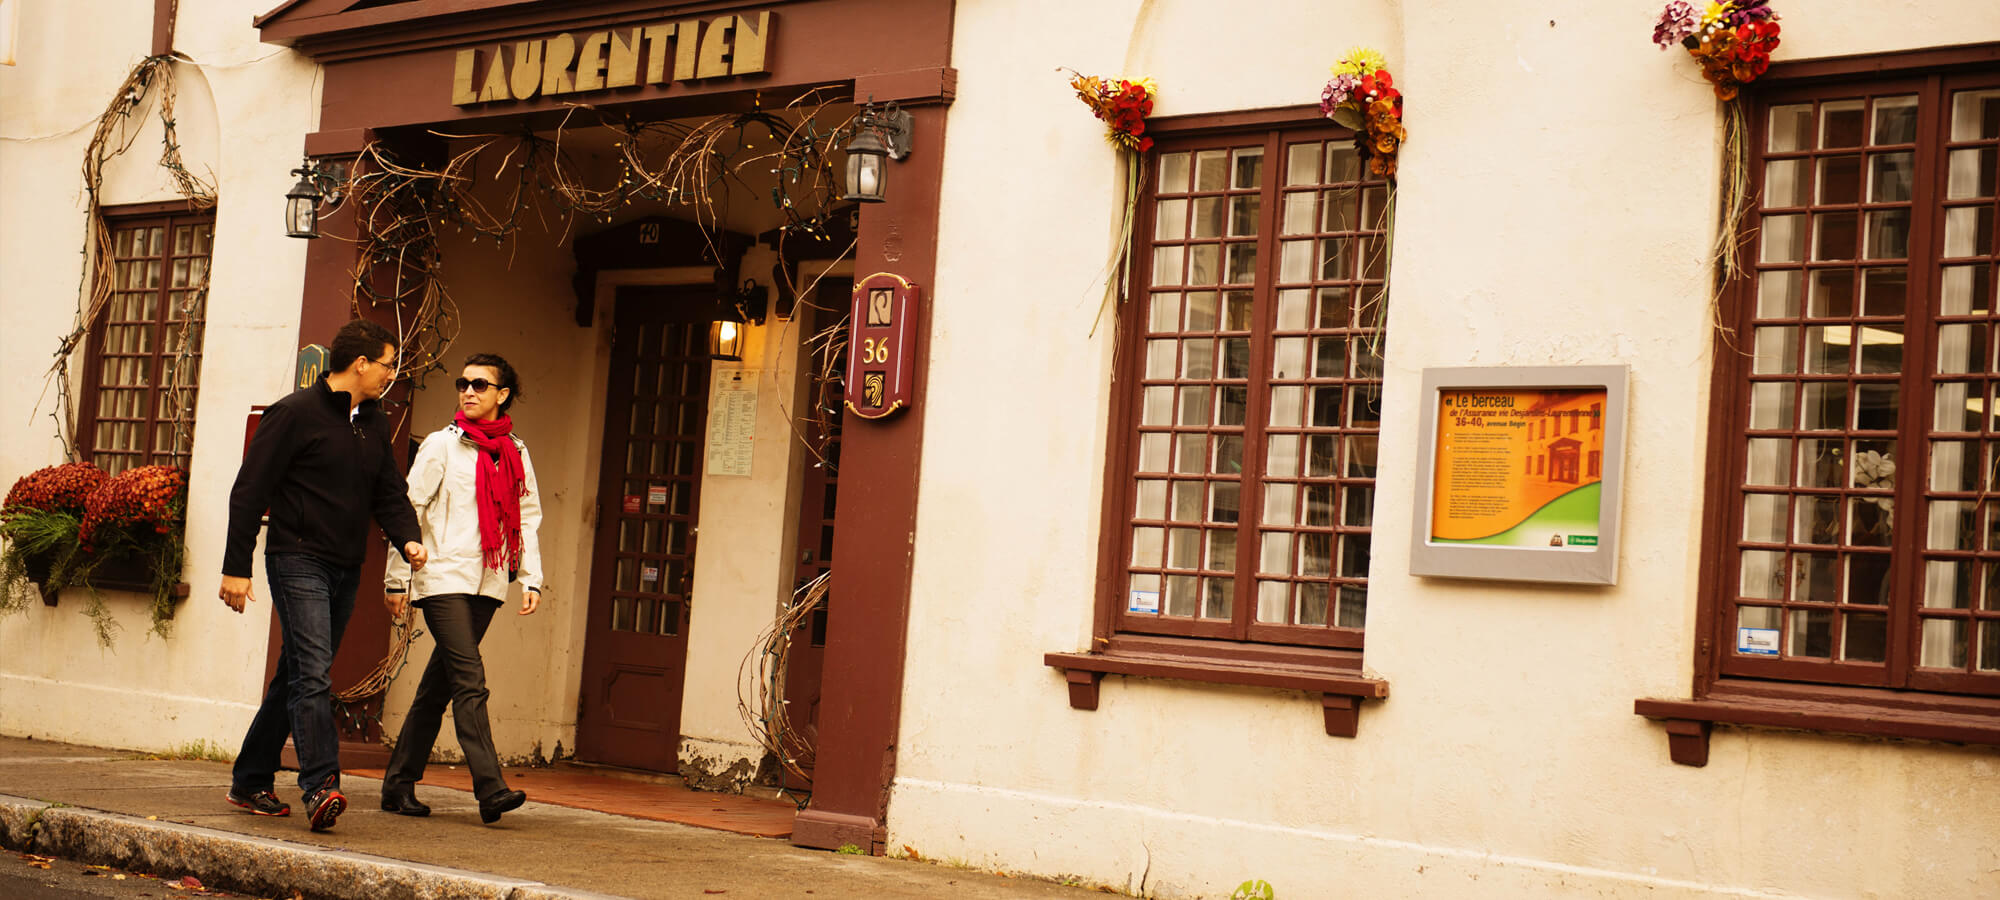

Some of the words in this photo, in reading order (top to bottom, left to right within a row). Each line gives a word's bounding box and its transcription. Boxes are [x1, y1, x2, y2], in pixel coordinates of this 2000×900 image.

[452, 11, 773, 105] LAURENTIEN
[640, 223, 658, 243] 40
[863, 336, 889, 364] 36
[300, 360, 317, 389] 40
[1456, 393, 1469, 407] Le
[1472, 393, 1514, 407] berceau
[1456, 417, 1485, 428] 36-40,
